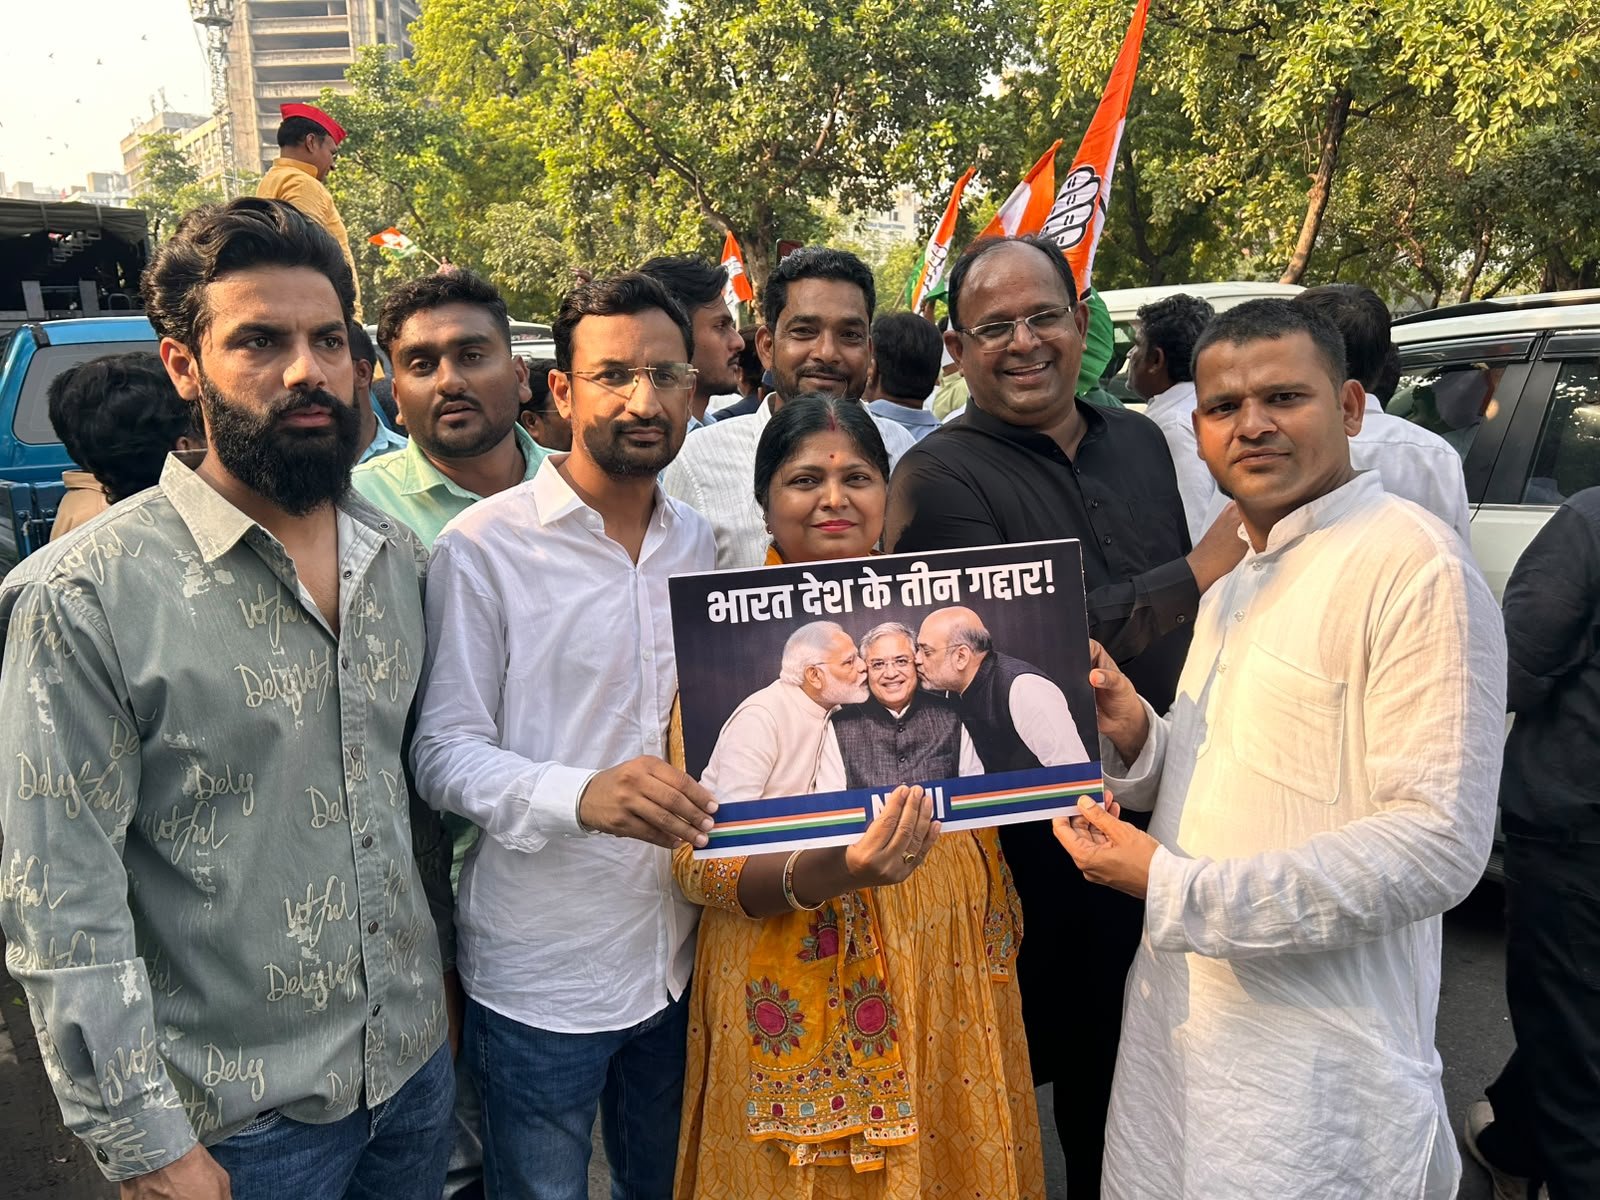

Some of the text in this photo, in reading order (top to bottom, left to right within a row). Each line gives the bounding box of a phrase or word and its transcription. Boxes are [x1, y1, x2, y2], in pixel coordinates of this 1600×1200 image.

[707, 559, 1056, 624] भारत देश के तीन गद्दार!
